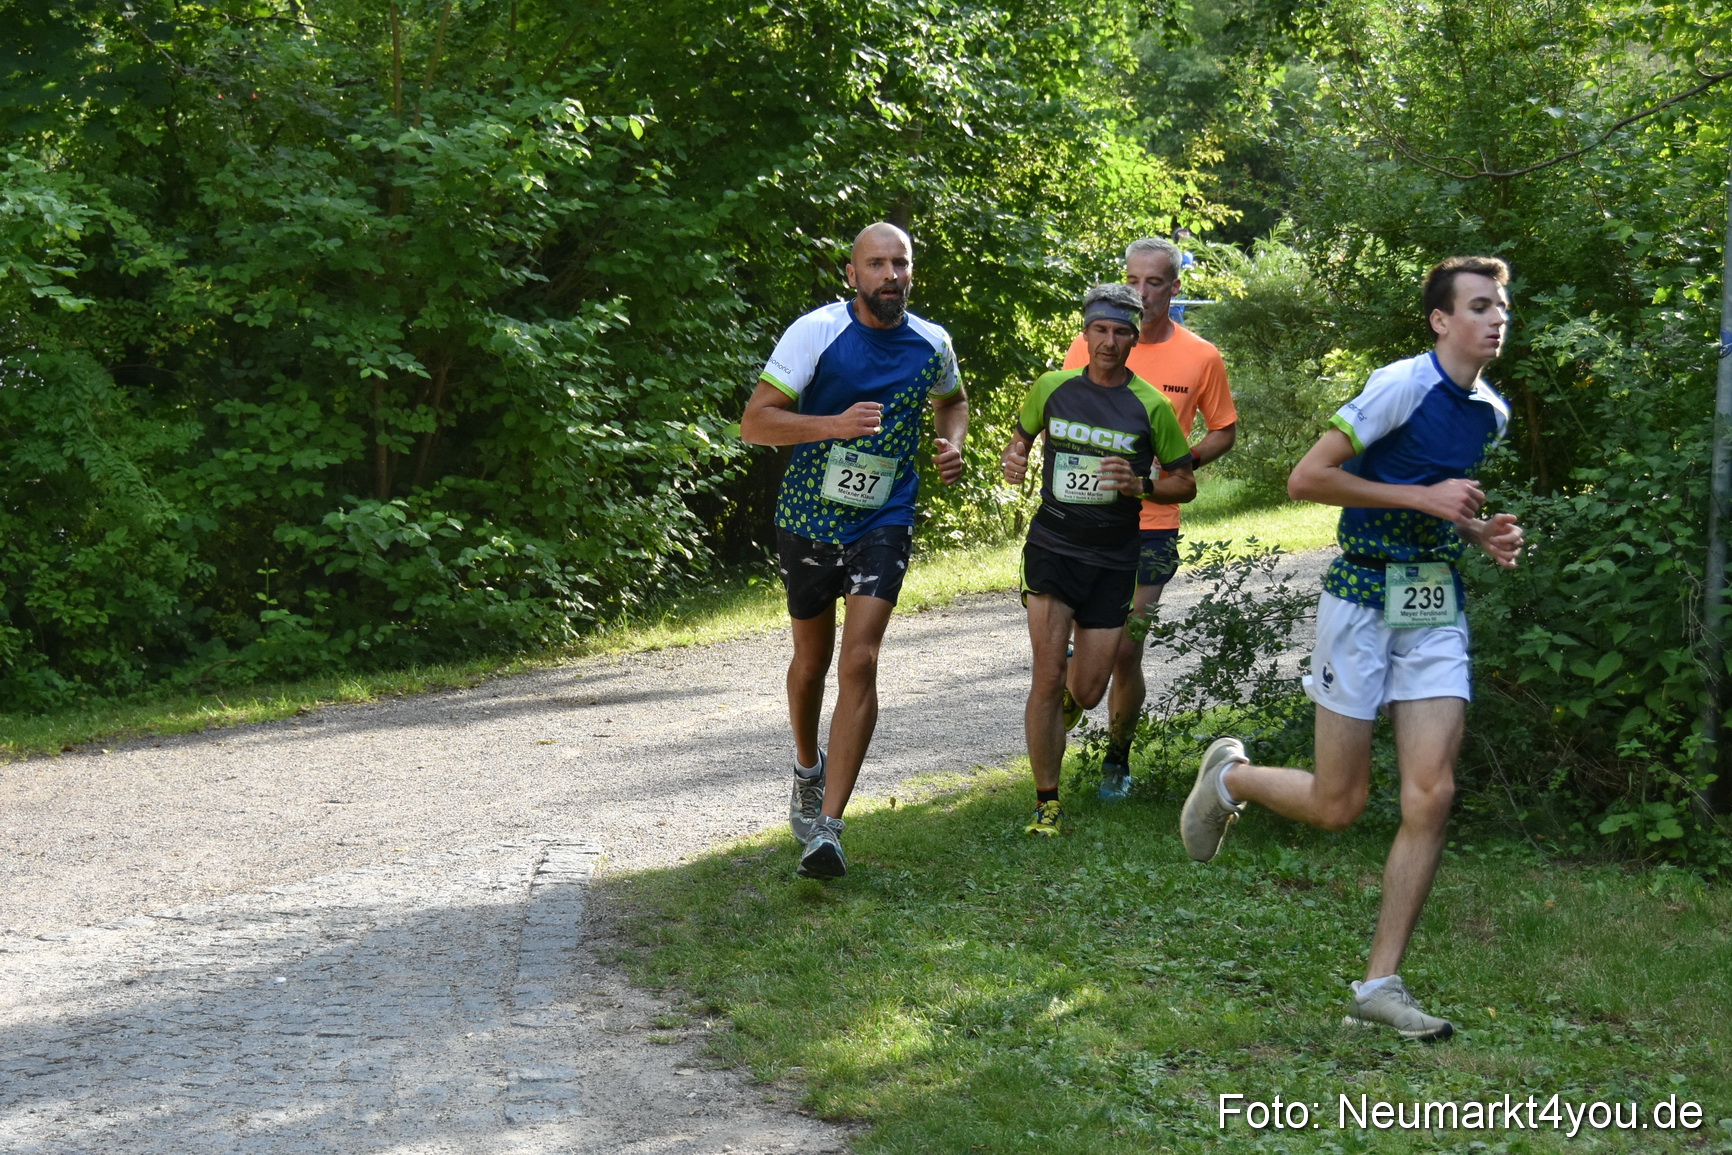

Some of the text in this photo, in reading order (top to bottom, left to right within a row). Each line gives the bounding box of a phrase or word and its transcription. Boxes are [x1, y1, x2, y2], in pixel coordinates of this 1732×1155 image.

[1162, 384, 1189, 394] THULE
[1049, 417, 1139, 455] BOCK
[838, 468, 881, 494] 237
[1066, 472, 1101, 492] 327
[1403, 586, 1444, 609] 239
